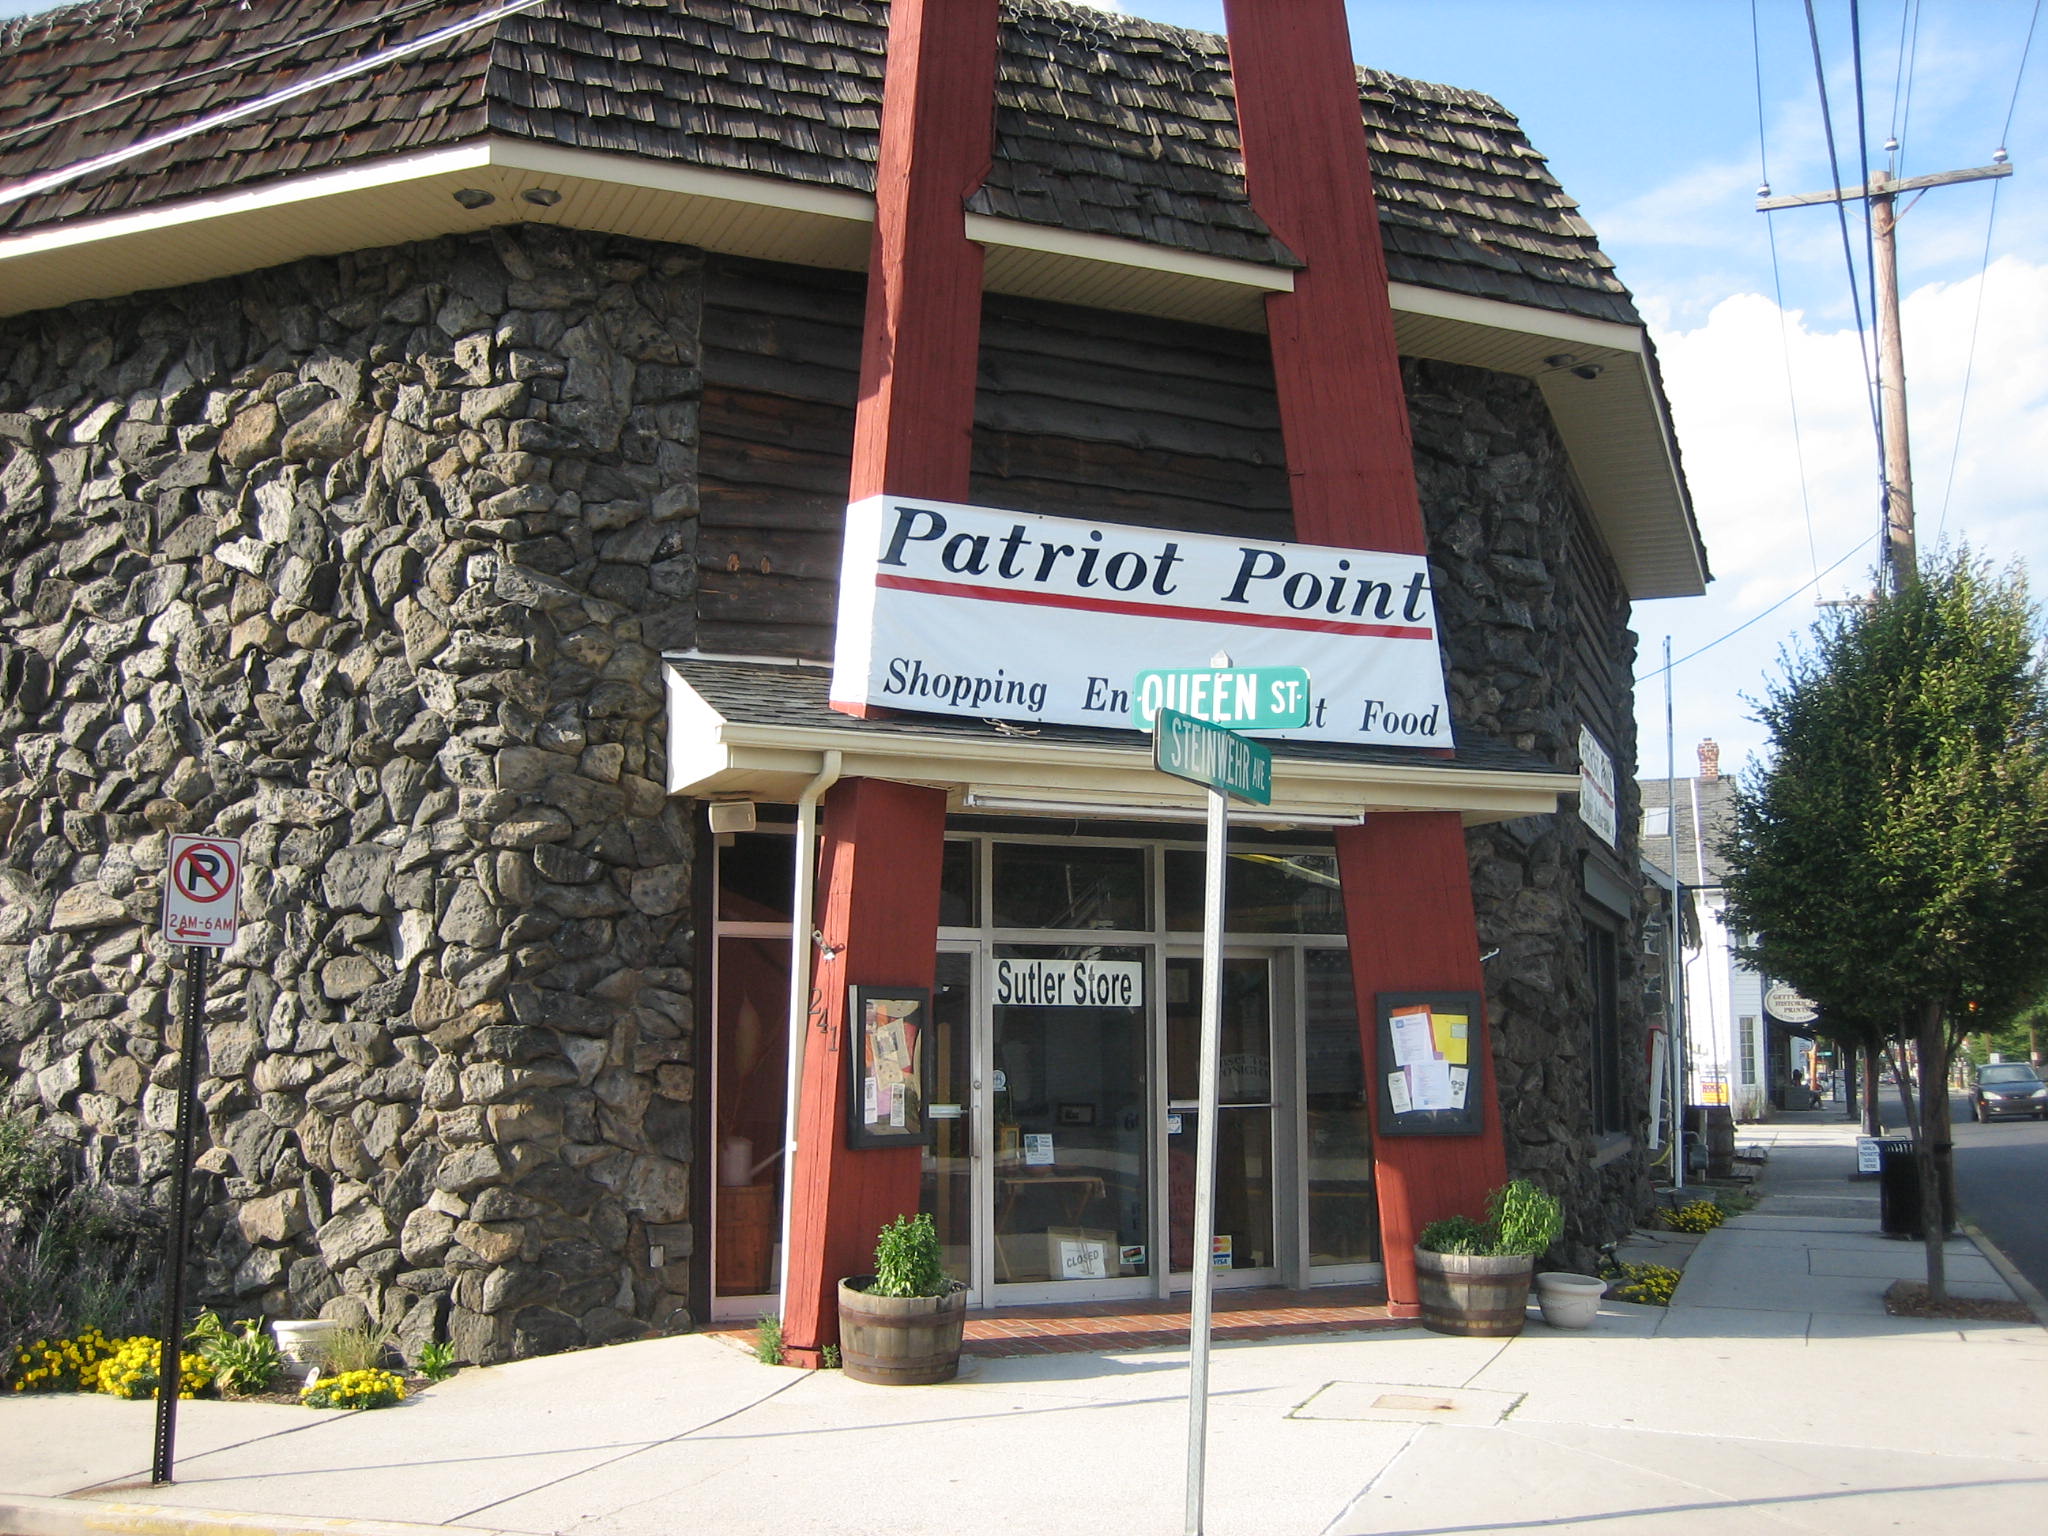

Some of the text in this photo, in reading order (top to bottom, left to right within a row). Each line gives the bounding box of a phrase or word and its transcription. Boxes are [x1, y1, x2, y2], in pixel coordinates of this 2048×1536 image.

[877, 506, 1431, 623] Patriot Point
[883, 657, 1048, 713] Shopping
[1142, 672, 1257, 722] QUEEN
[1271, 680, 1300, 714] ST
[1358, 699, 1440, 737] Food
[1171, 717, 1266, 792] STEINWEHR AVE
[997, 960, 1132, 1005] Sutler Store
[1066, 1249, 1099, 1268] CLOSED
